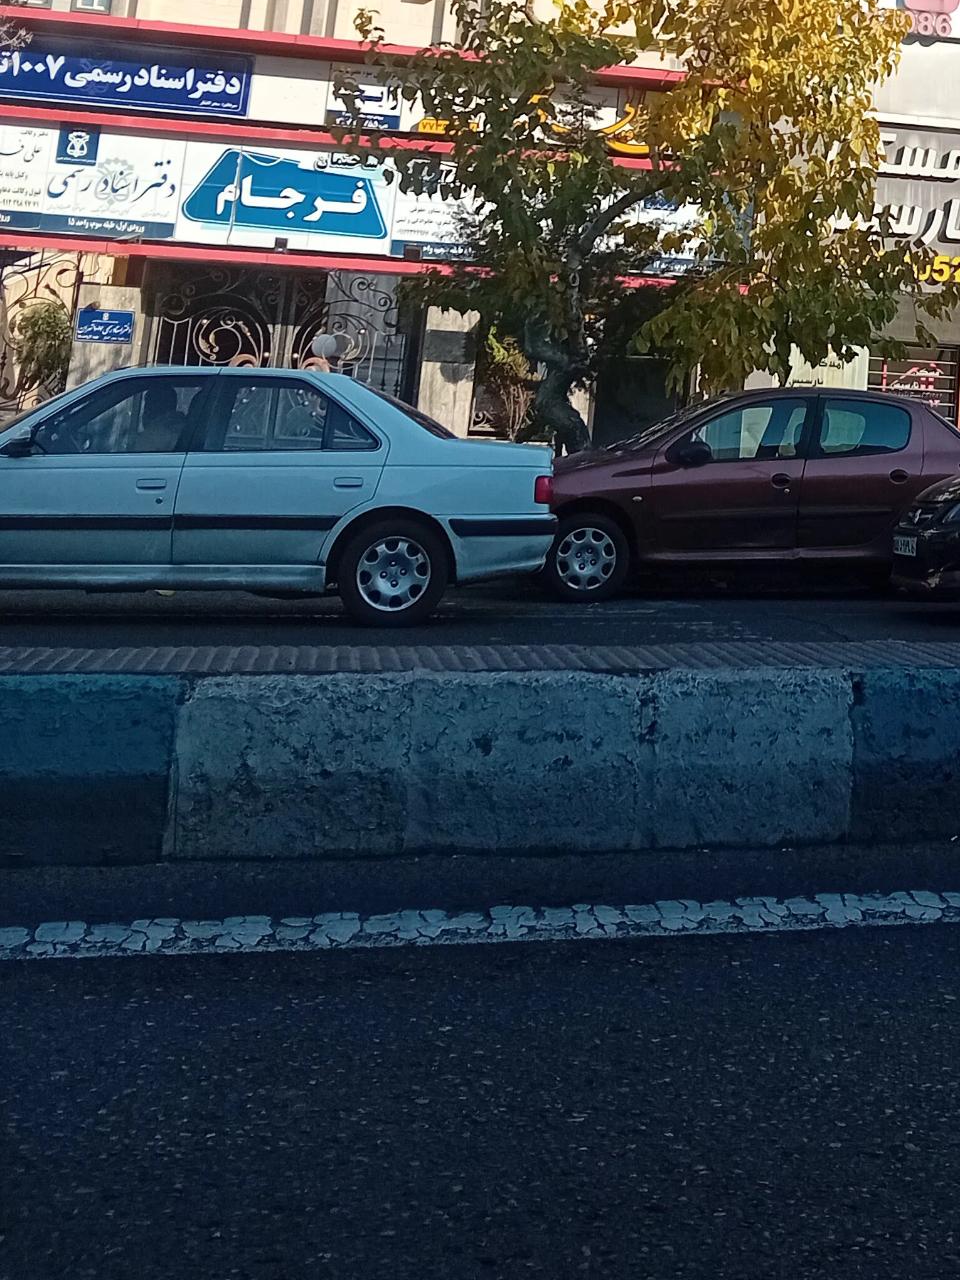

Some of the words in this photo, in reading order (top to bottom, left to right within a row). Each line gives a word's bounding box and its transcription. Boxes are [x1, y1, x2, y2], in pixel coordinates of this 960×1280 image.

[64, 67, 131, 93] رسمی
[133, 65, 194, 91] اسناد
[188, 70, 241, 98] دفتر
[316, 152, 378, 169] سختمان
[47, 168, 92, 198] رسمی
[100, 170, 139, 194] اسناد
[131, 159, 176, 203] دفتر
[216, 175, 368, 221] فرجام
